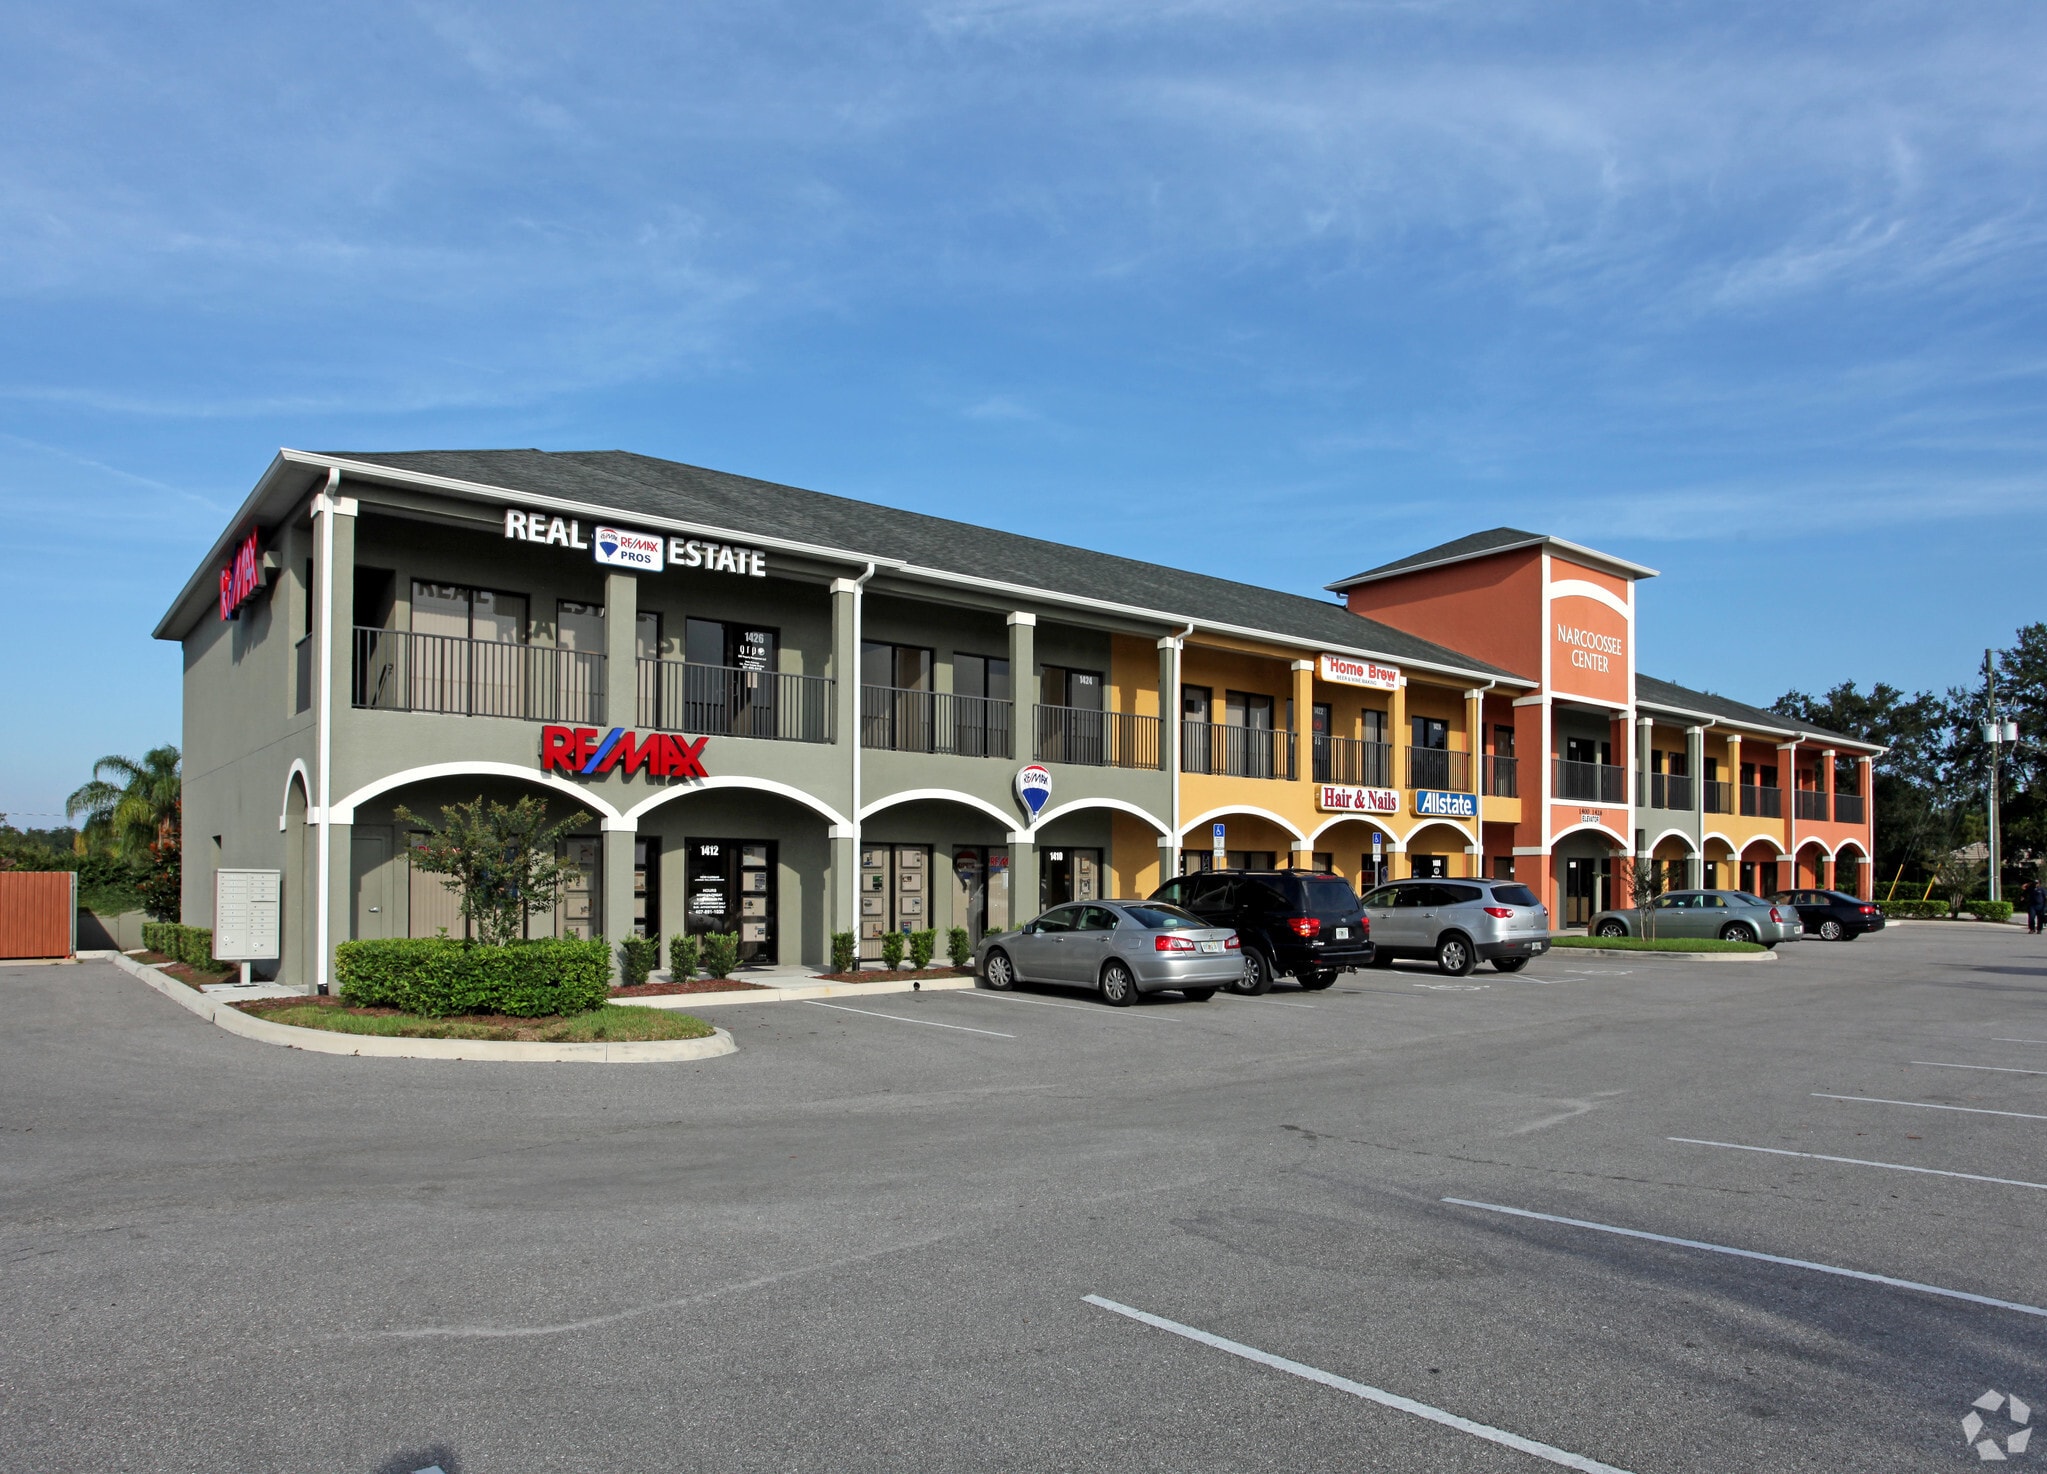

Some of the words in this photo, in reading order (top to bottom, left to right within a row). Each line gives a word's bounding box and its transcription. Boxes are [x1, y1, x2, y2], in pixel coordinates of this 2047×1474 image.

[505, 508, 588, 550] REAL
[620, 536, 659, 553] RE/MAX
[667, 536, 767, 577] ESTATE
[621, 551, 652, 564] PROS
[744, 632, 765, 643] 1426
[1557, 623, 1622, 656] NARCOOSSEE
[1331, 658, 1363, 676] Home
[1369, 664, 1396, 681] Brew
[1571, 649, 1609, 673] CENTER
[543, 725, 709, 777] RE/MAX
[1323, 787, 1352, 808] Hair
[1354, 789, 1366, 809] &
[1367, 790, 1397, 811] Nails
[1421, 791, 1473, 815] Allstate
[700, 845, 719, 856] 1412
